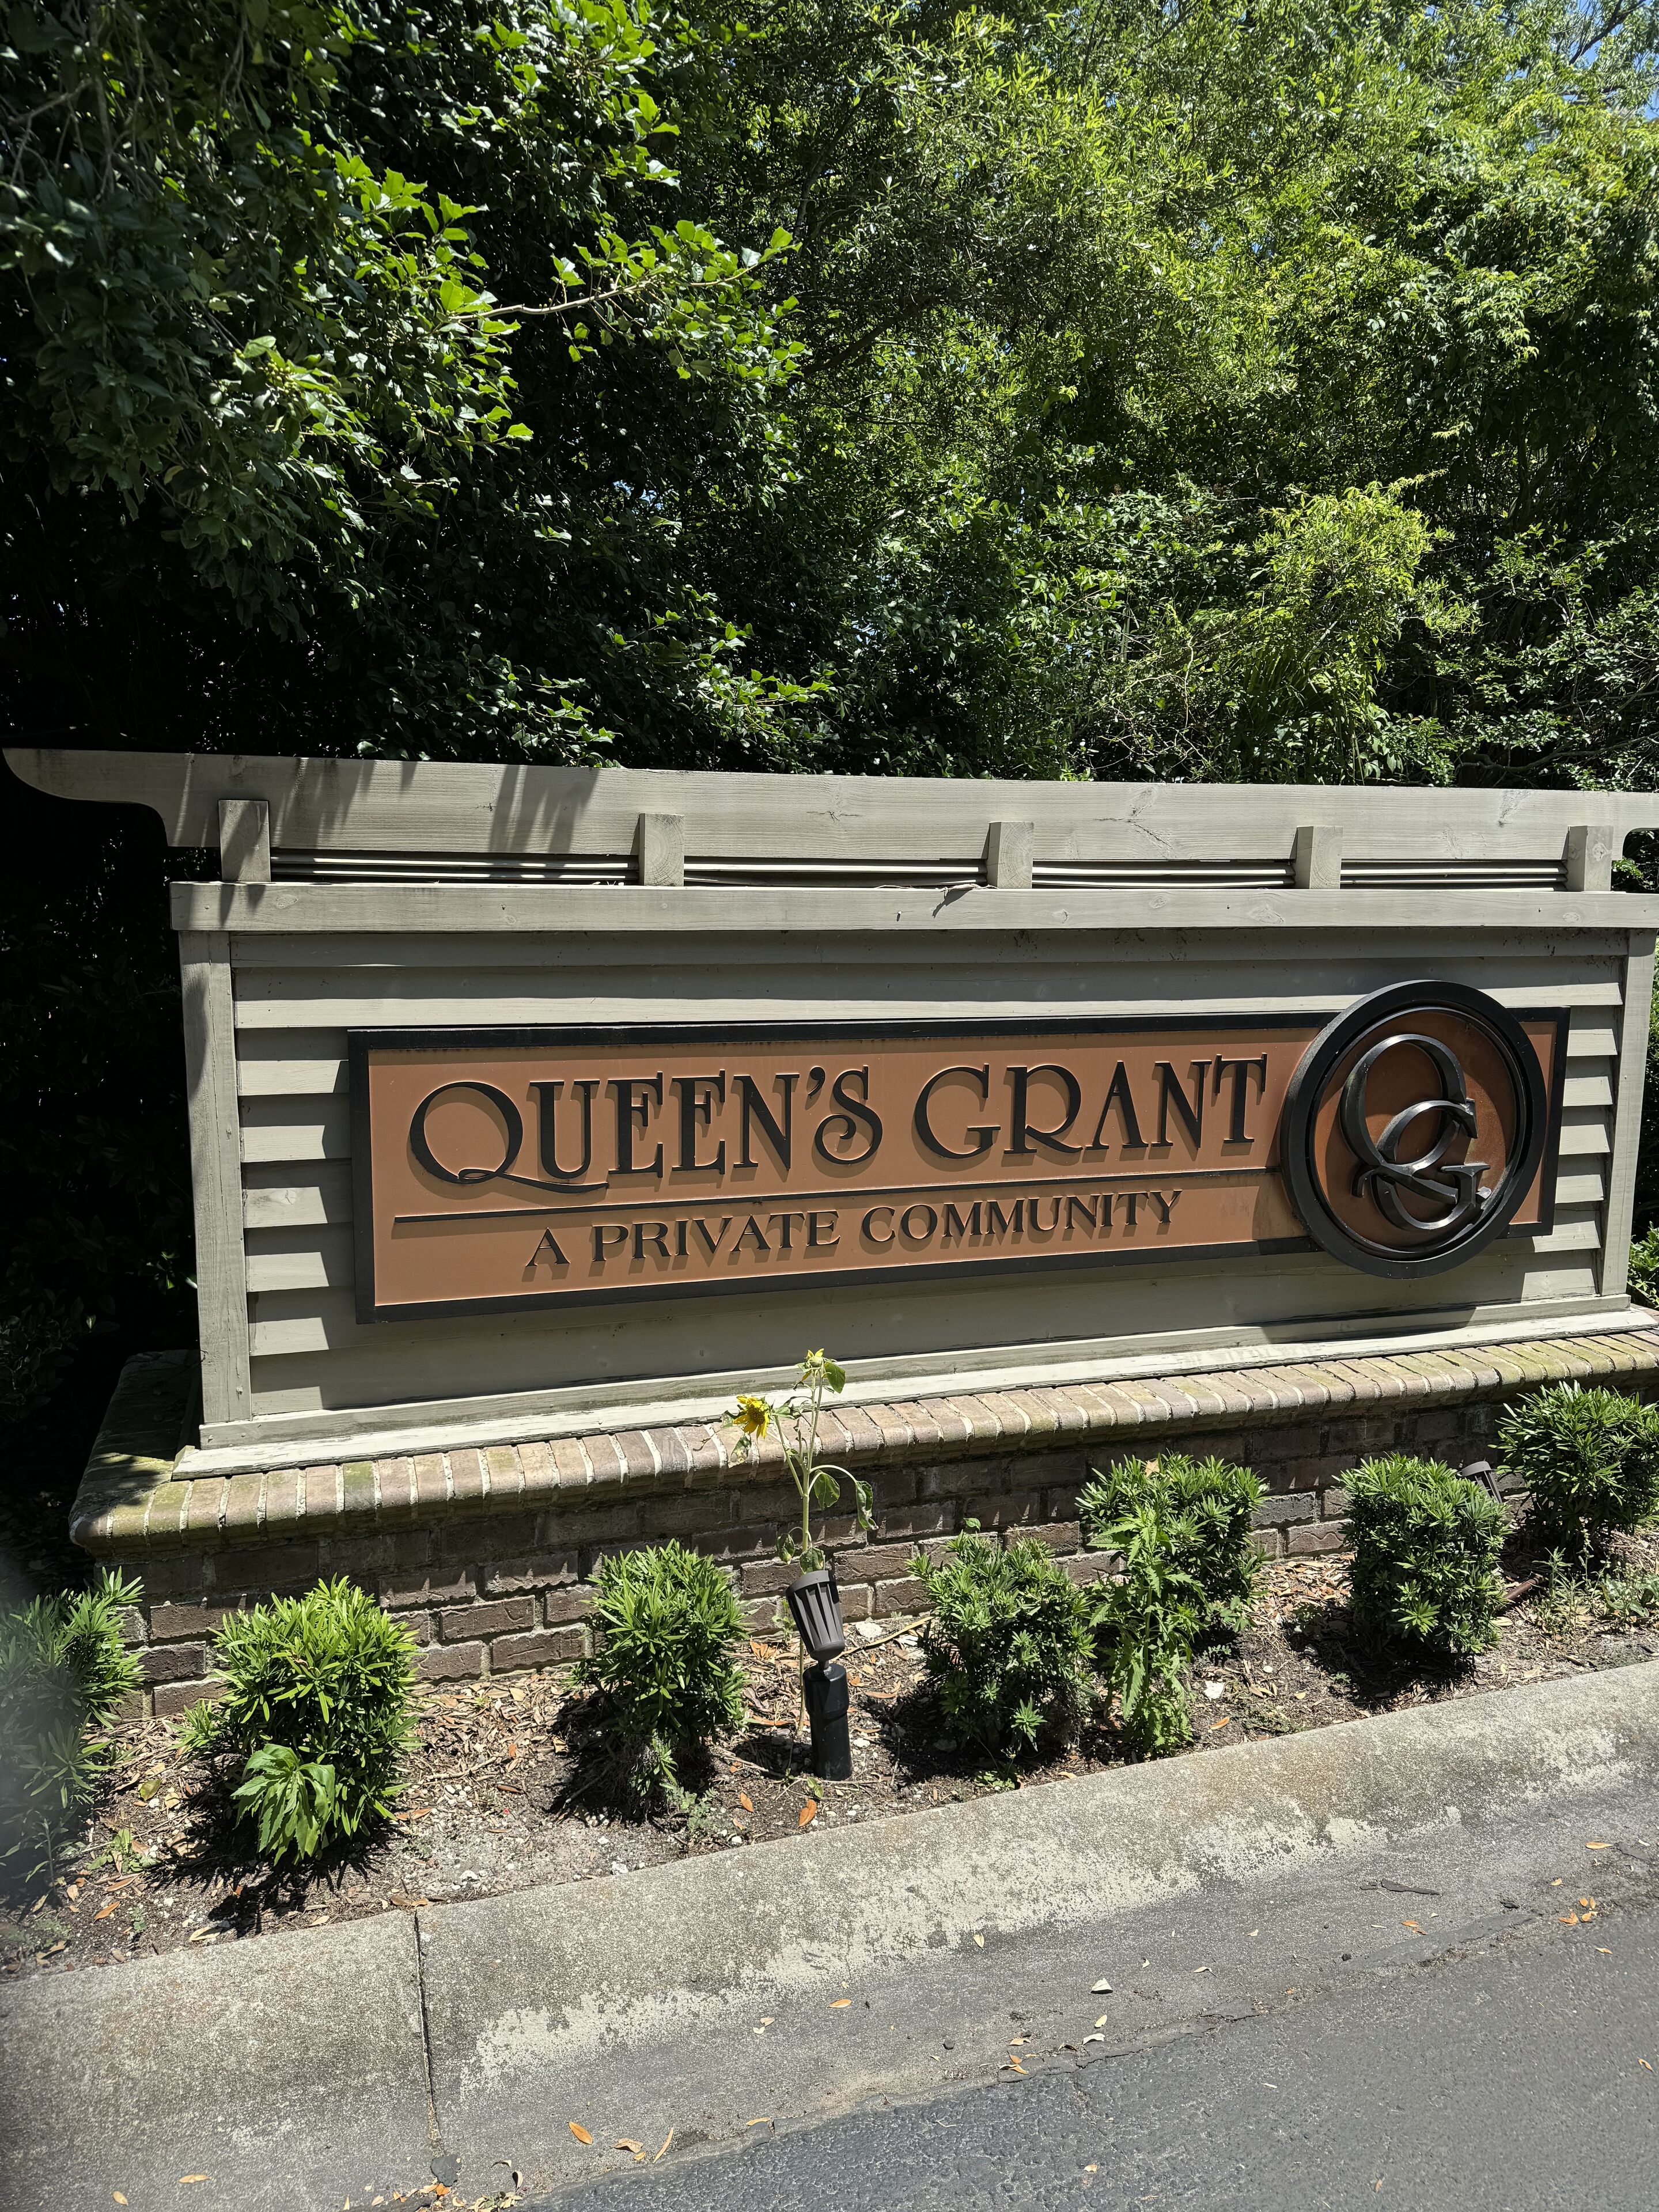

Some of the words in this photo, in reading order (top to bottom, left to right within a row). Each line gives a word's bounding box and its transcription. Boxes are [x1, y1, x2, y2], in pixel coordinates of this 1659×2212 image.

[409, 1065, 884, 1194] QUEEN'S
[914, 1052, 1268, 1159] GRANT
[525, 1227, 570, 1267] A
[591, 1210, 841, 1263] PRIVATE
[862, 1189, 1183, 1243] COMMUNITY
